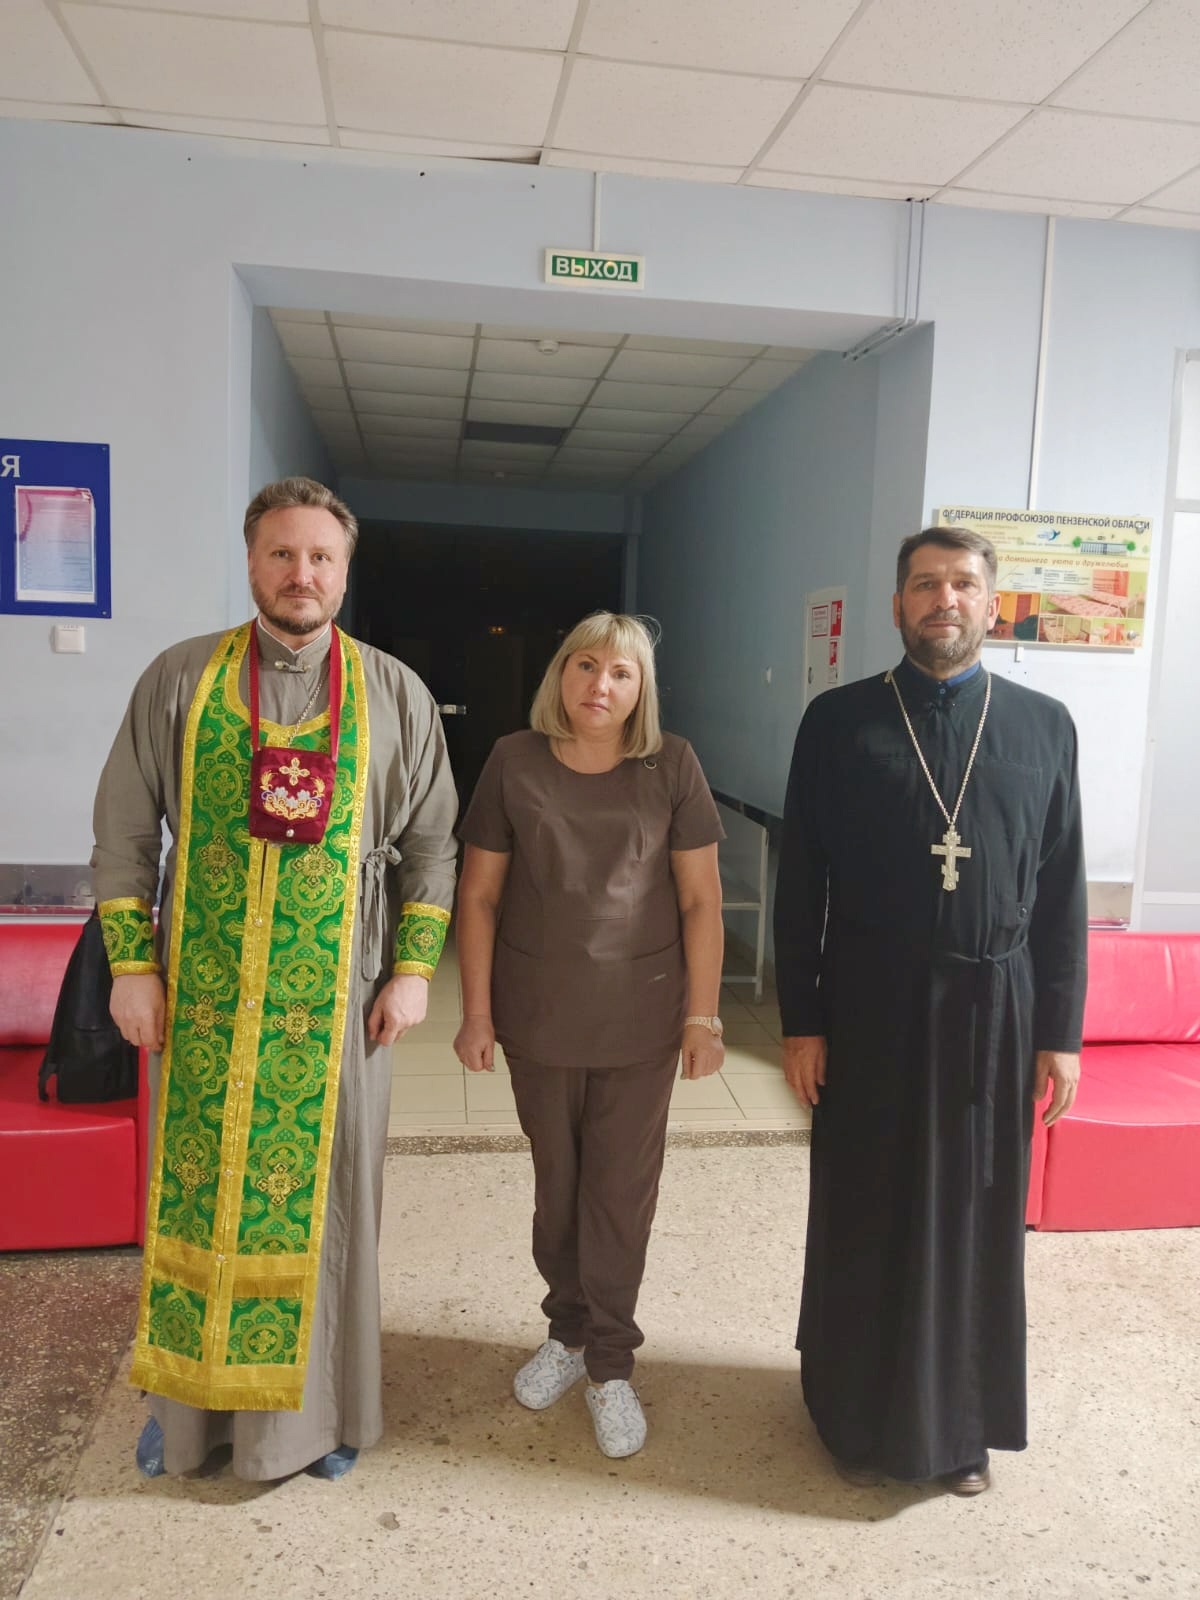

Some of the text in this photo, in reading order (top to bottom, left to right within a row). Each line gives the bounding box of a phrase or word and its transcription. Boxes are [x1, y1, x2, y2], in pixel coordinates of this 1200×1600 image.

[555, 257, 633, 281] ВЫХОД
[942, 509, 1150, 530] ФЕДЕРАЦИЯ ПРОФСОЮЗОВ ПЕНЗЕНСКОЙ ОБЛАСТИ
[1005, 555, 1048, 564] домашнего
